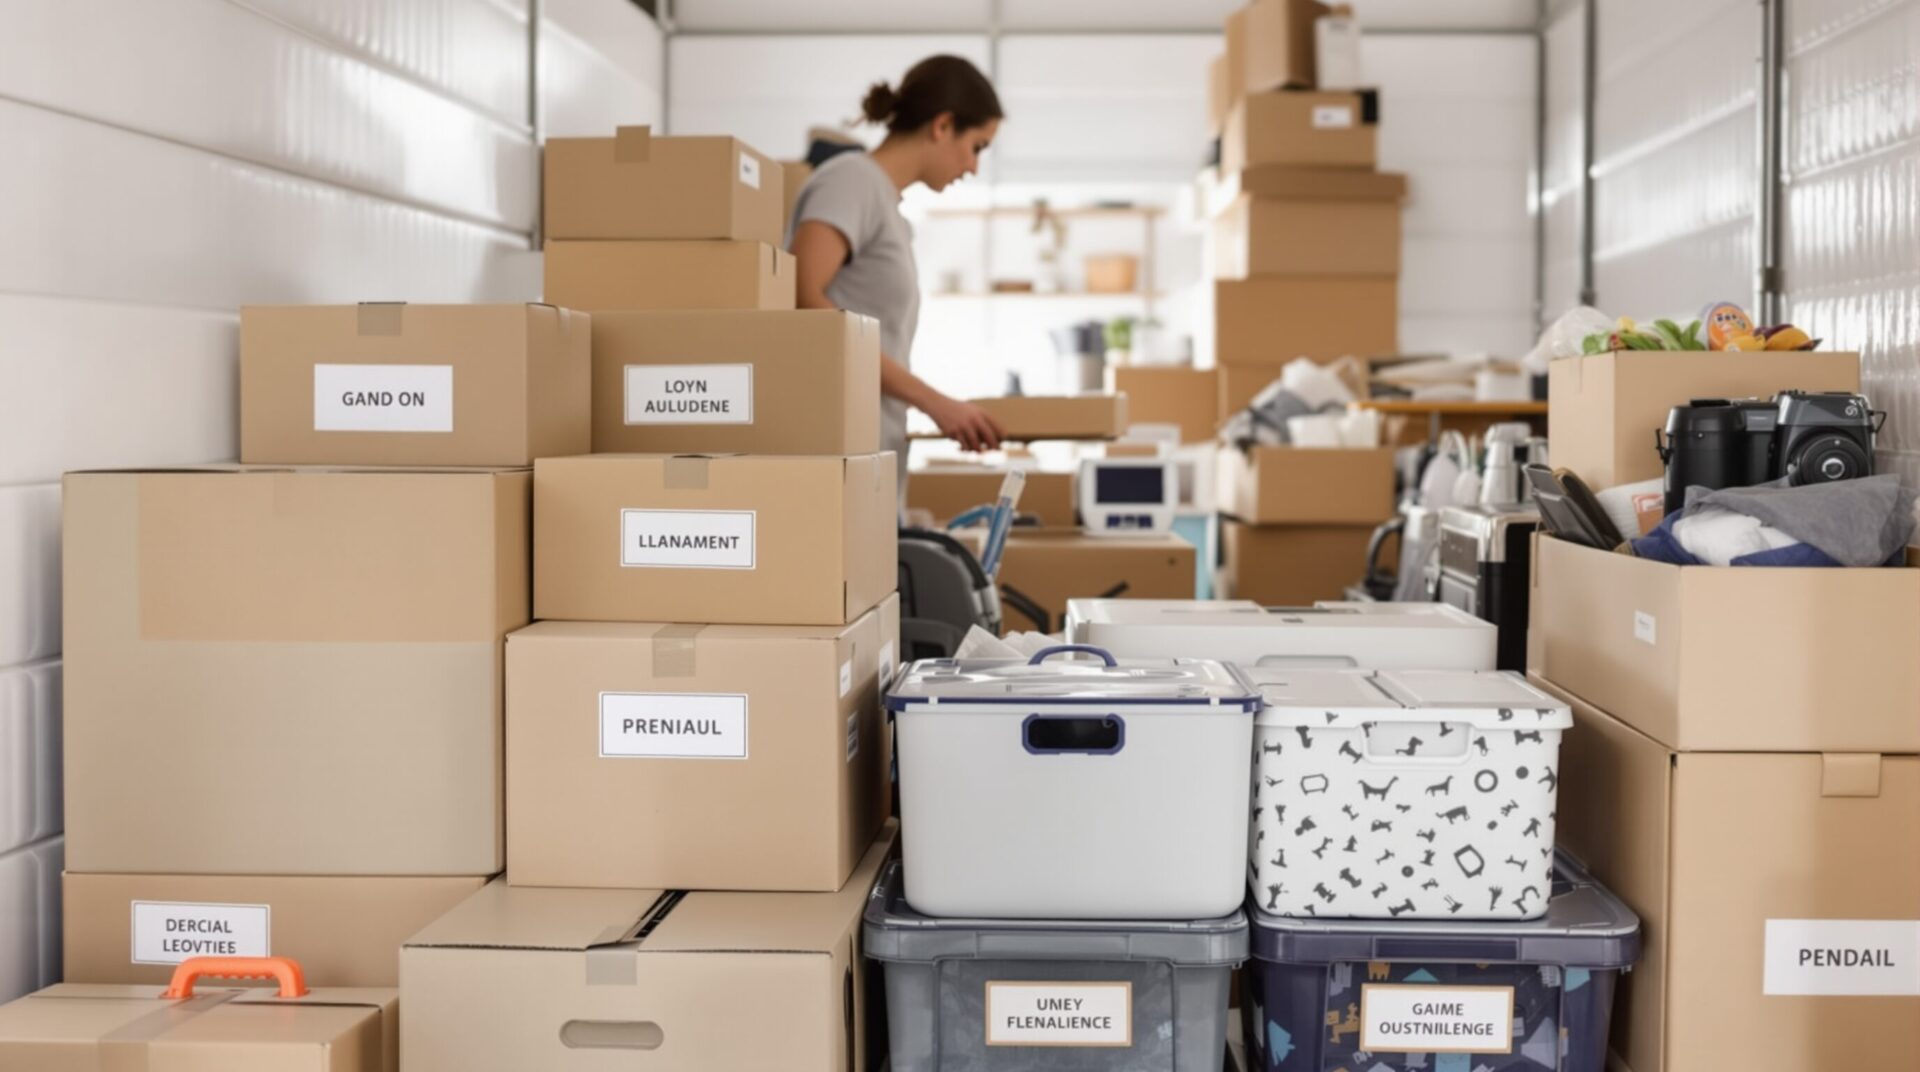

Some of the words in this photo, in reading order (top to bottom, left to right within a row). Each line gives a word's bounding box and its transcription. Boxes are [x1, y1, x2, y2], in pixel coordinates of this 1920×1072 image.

[665, 380, 707, 394] LOYN
[342, 391, 393, 406] GAND
[398, 391, 425, 406] ON
[644, 399, 730, 413] AULUDENE
[639, 534, 740, 550] LLANAMENT
[623, 718, 722, 735] PRENIAUL
[165, 918, 233, 934] DERCIAL
[1799, 948, 1895, 967] PENDAIL
[1412, 1002, 1464, 1016] GAIME
[1007, 1016, 1112, 1029] FLENALIENCE
